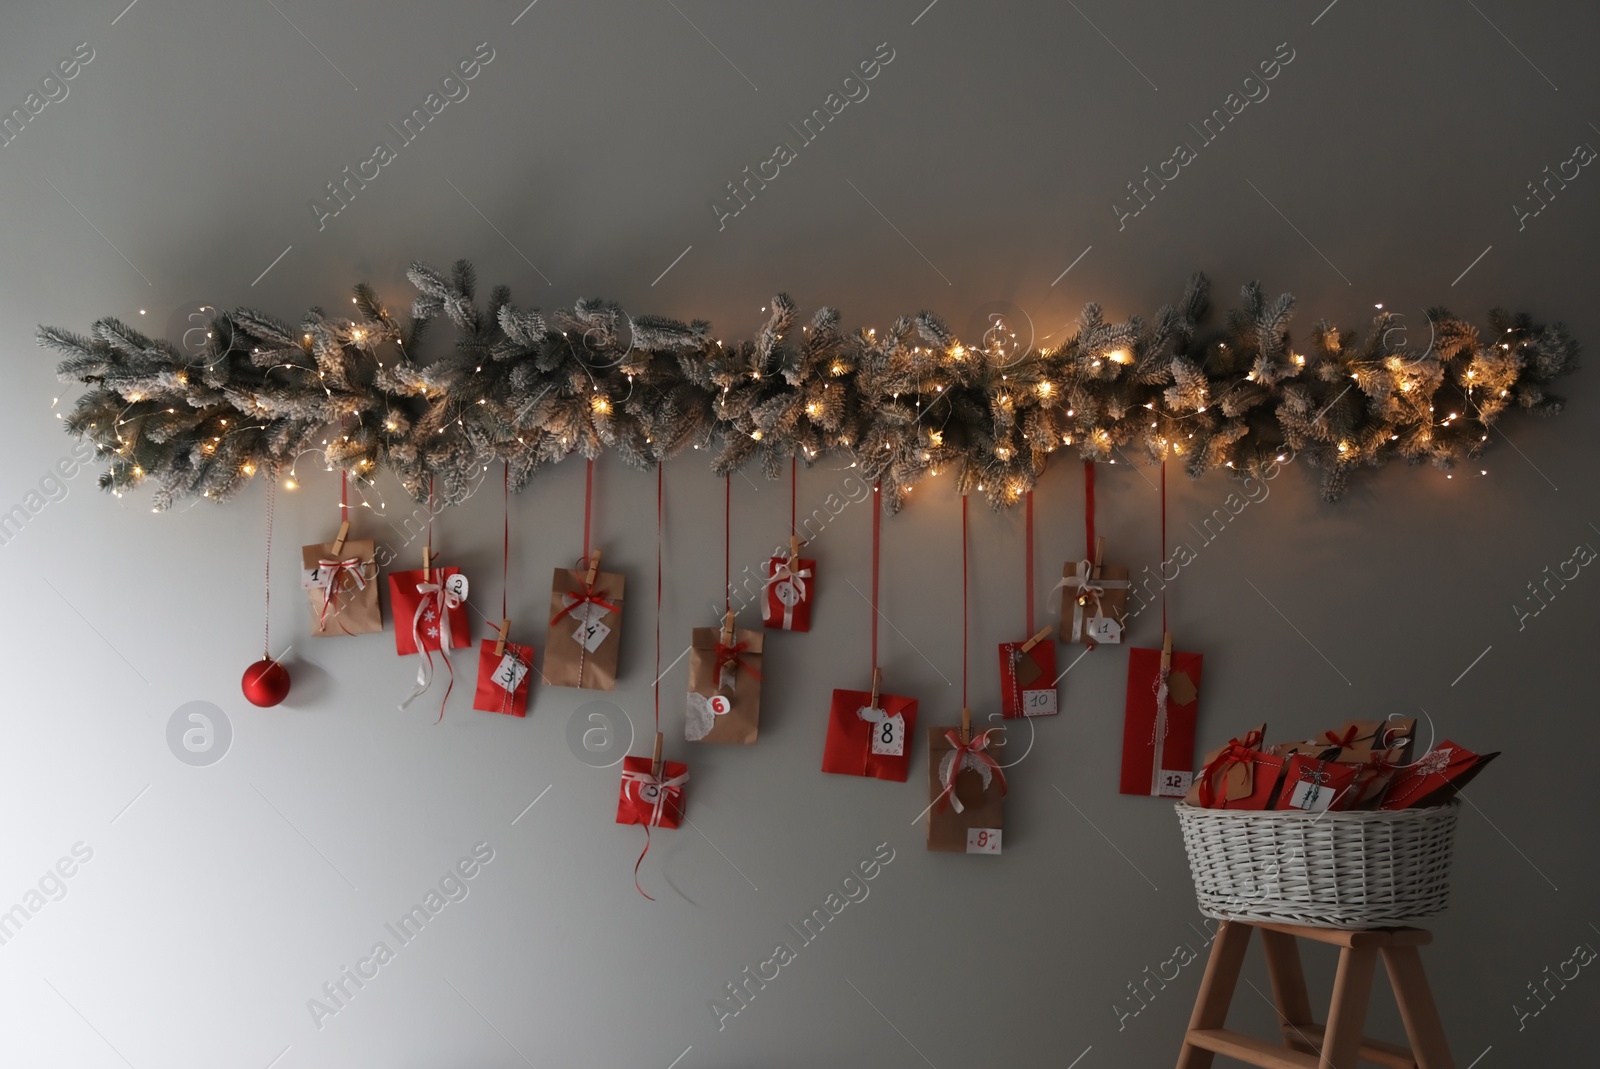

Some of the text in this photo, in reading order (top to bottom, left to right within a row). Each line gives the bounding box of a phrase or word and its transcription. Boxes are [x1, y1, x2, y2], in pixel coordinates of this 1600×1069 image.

[311, 569, 319, 580] 1
[453, 580, 463, 595] 2
[587, 626, 596, 639] 4
[501, 667, 514, 683] 3
[712, 697, 725, 713] 6
[1030, 694, 1048, 707] 10
[881, 722, 893, 744] 8
[1166, 775, 1182, 788] 12
[977, 831, 988, 847] 9
